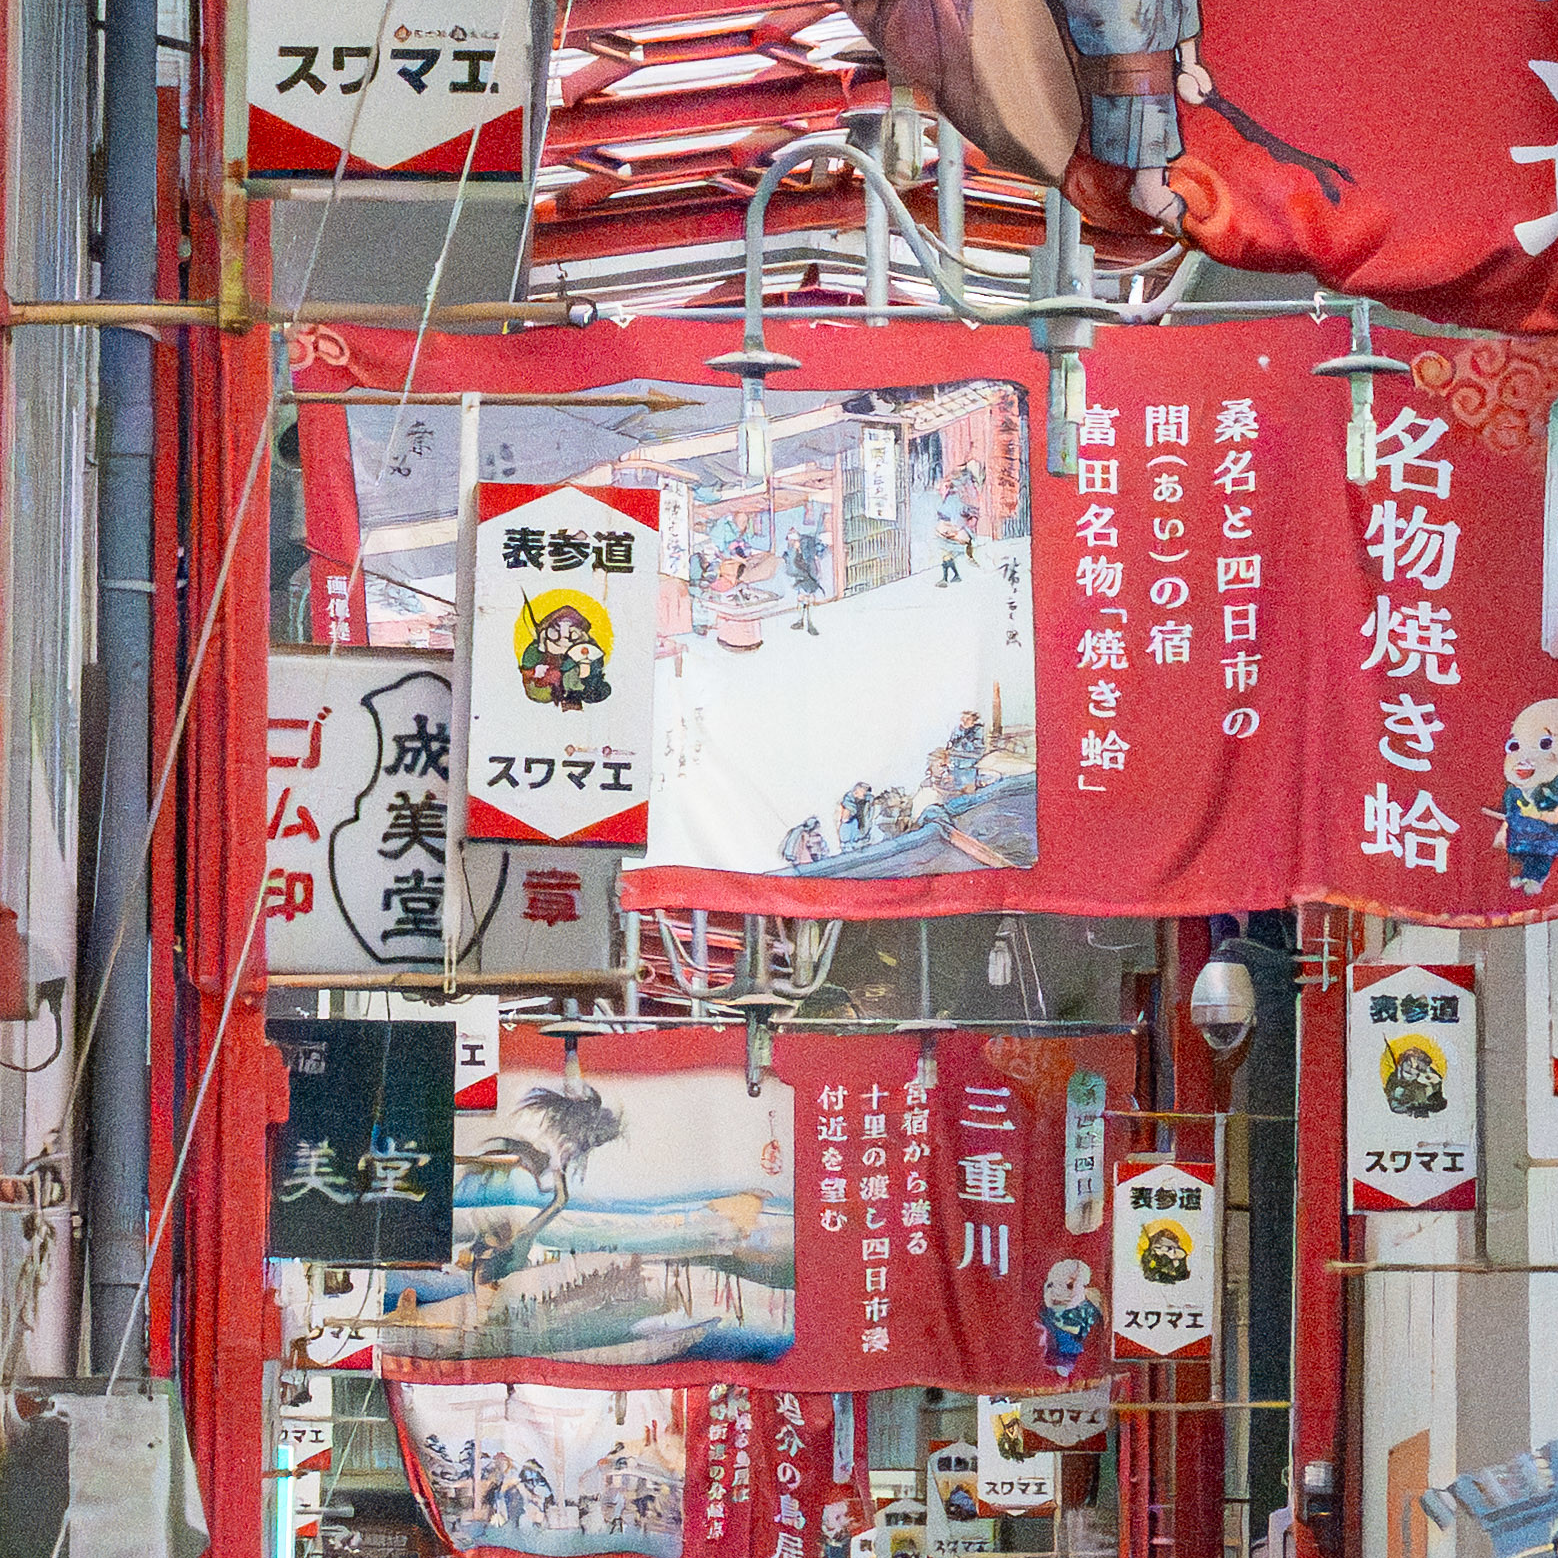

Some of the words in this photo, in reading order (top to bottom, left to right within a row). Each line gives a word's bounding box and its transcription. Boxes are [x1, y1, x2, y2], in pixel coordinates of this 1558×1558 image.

[275, 45, 499, 96] スワマエ
[502, 527, 636, 574] 表参道
[1214, 397, 1262, 739] 桑名と四日市の
[1076, 403, 1132, 794] 富田名物「焼き蛤」
[1361, 405, 1462, 874] 名物焼き蛤
[486, 755, 634, 792] スワマエ
[378, 713, 452, 944] 成美堂
[1369, 994, 1460, 1025] 表参道
[816, 1084, 849, 1233] 付近を望む
[956, 1085, 1016, 1276] 三重川
[1365, 1150, 1466, 1174] スワマエ
[1130, 1186, 1203, 1212] 表参道
[1124, 1309, 1205, 1330] スワマエ
[1032, 1407, 1101, 1426] スワマエ
[985, 1481, 1048, 1497] スワマエ
